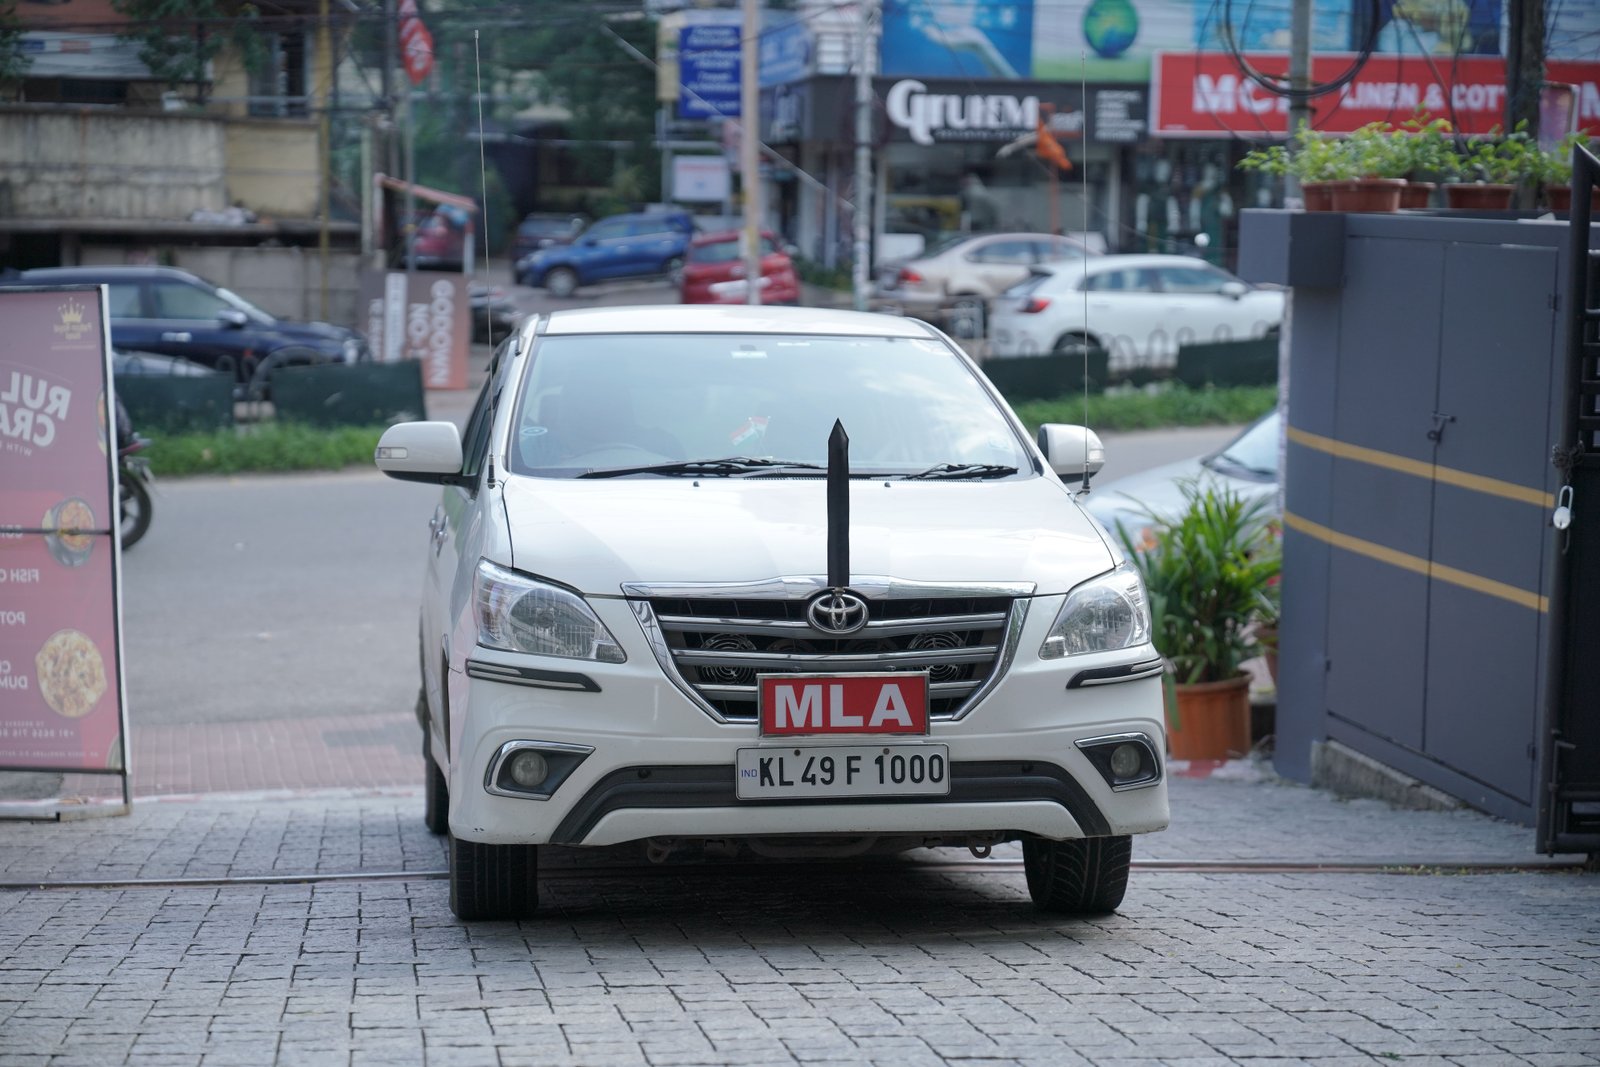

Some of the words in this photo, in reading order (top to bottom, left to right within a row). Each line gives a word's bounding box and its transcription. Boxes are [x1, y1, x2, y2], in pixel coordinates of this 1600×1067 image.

[1341, 82, 1419, 110] LINEN
[1425, 83, 1445, 111] &
[1451, 84, 1507, 112] COT
[430, 279, 455, 385] GODOWN
[774, 683, 913, 728] MLA
[741, 769, 758, 778] IND
[759, 757, 794, 787] KL
[801, 756, 835, 786] 49
[846, 755, 862, 785] F
[874, 754, 944, 785] 1000
